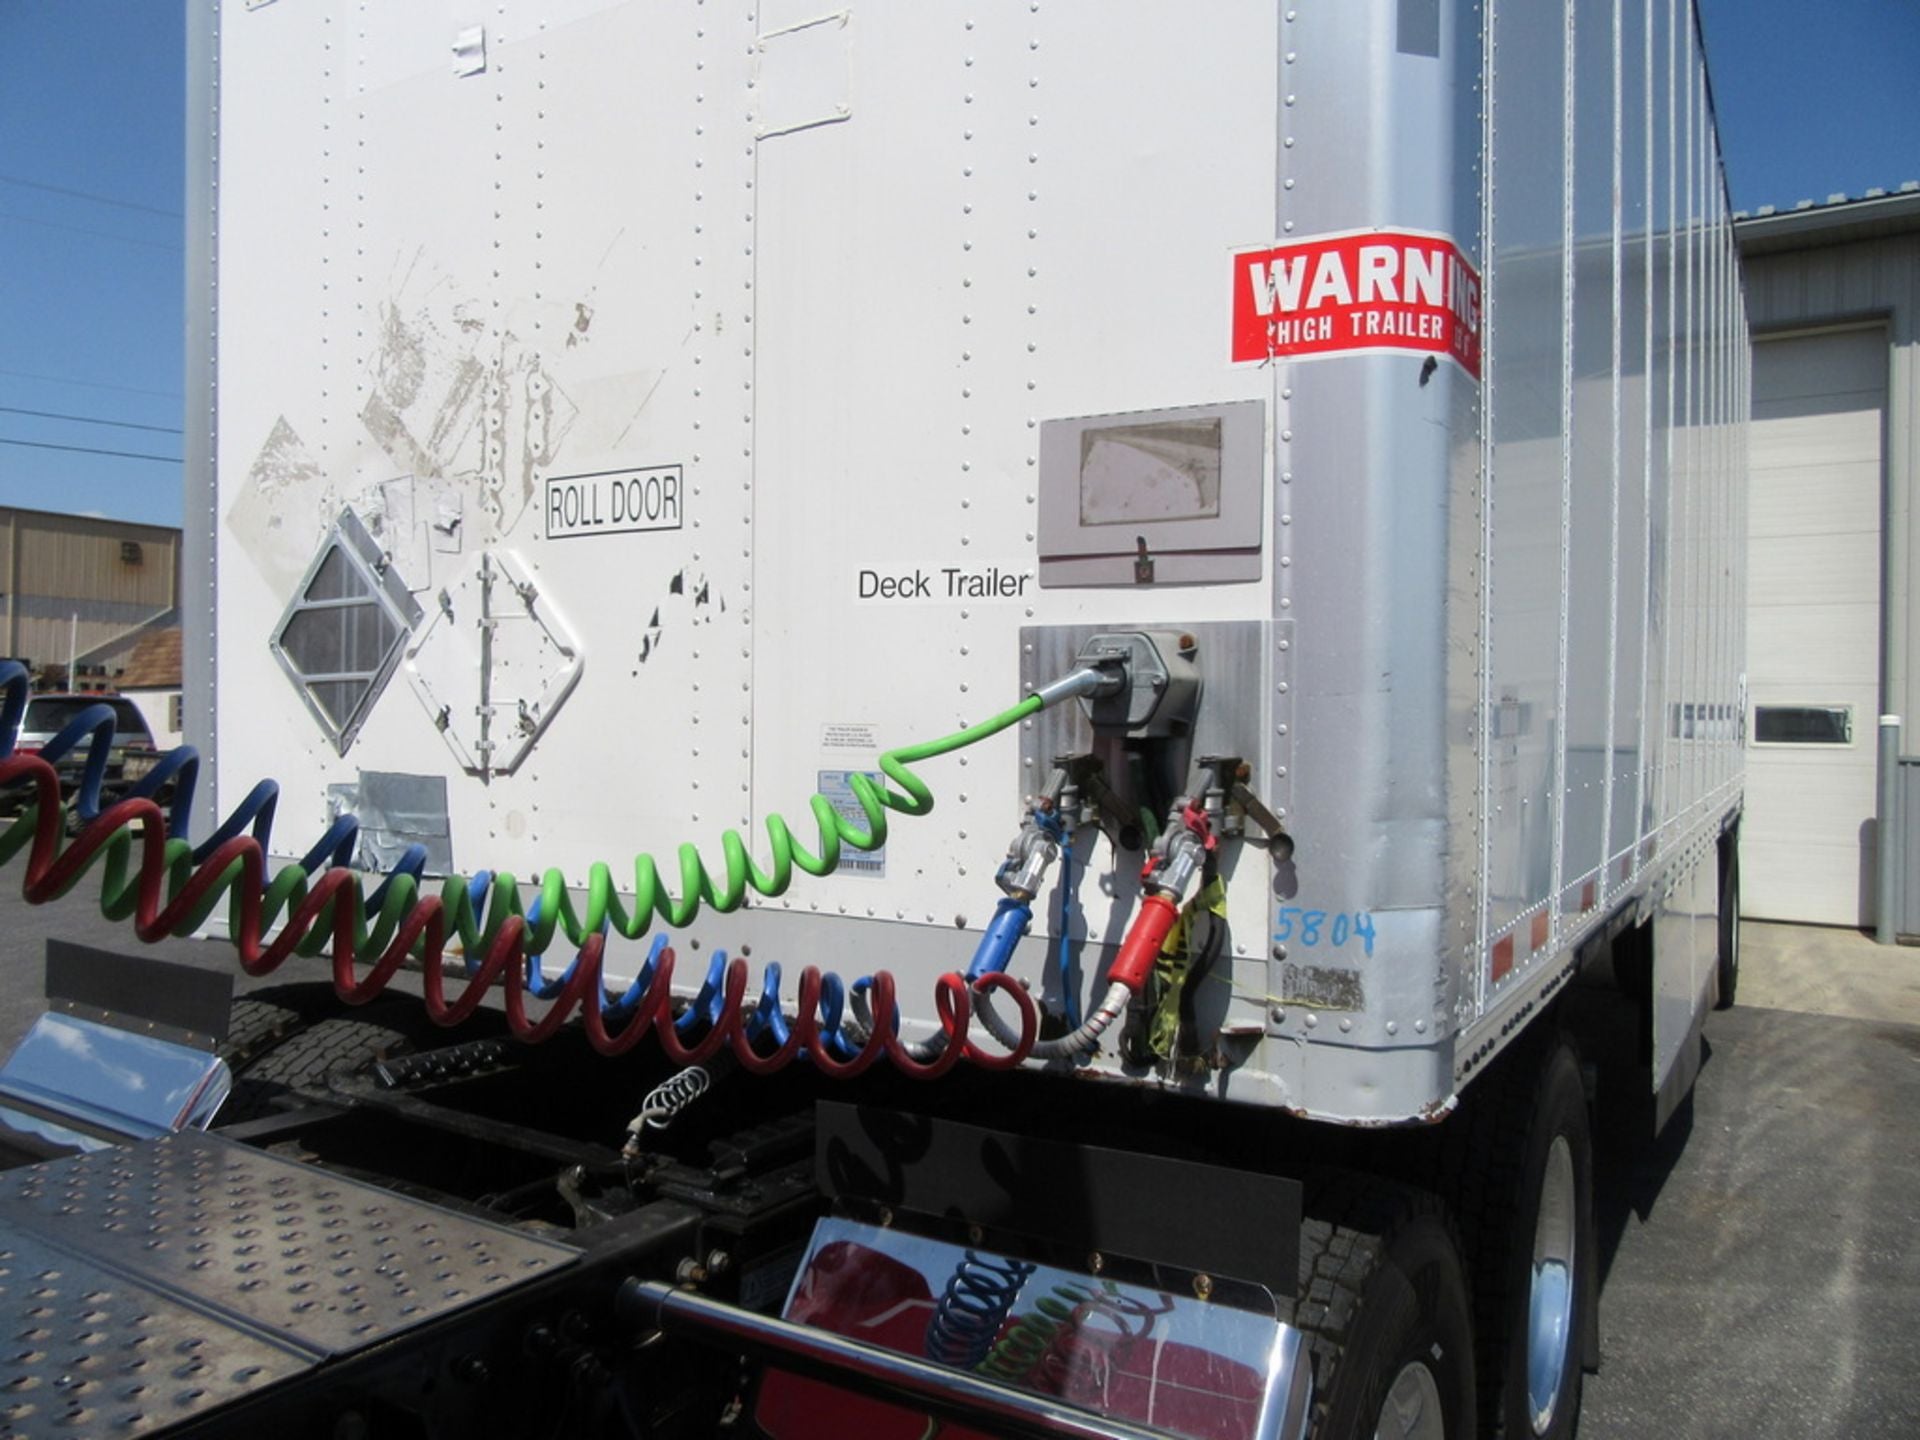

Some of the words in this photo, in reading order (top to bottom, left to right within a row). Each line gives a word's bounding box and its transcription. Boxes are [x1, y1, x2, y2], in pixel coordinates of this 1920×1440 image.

[1249, 244, 1477, 333] WARNING
[1277, 315, 1332, 345] HIGH
[1350, 310, 1444, 340] TRAILER
[550, 485, 604, 529] ROLL
[611, 475, 678, 524] DOOR
[859, 569, 931, 598] Deck
[941, 567, 1029, 597] Trailer
[1273, 906, 1376, 958] 5804
